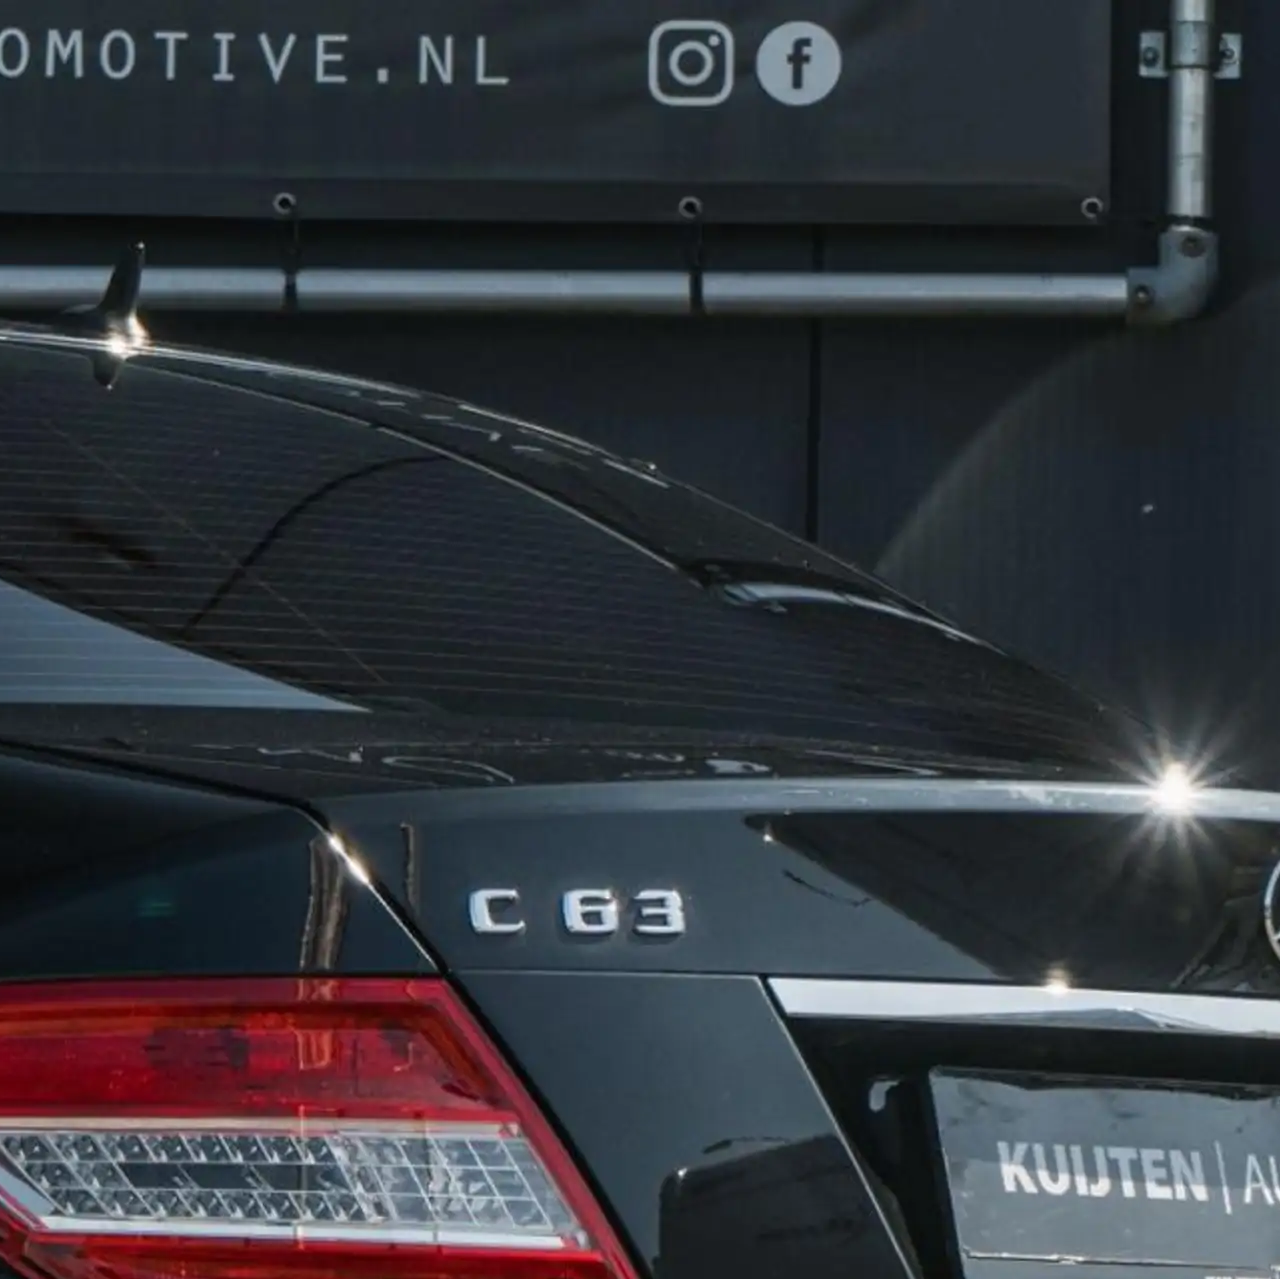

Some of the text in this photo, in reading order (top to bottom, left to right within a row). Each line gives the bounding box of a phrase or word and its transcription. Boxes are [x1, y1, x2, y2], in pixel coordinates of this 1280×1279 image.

[469, 888, 686, 934] C 63
[996, 1140, 1210, 1202] KUIJTEN
